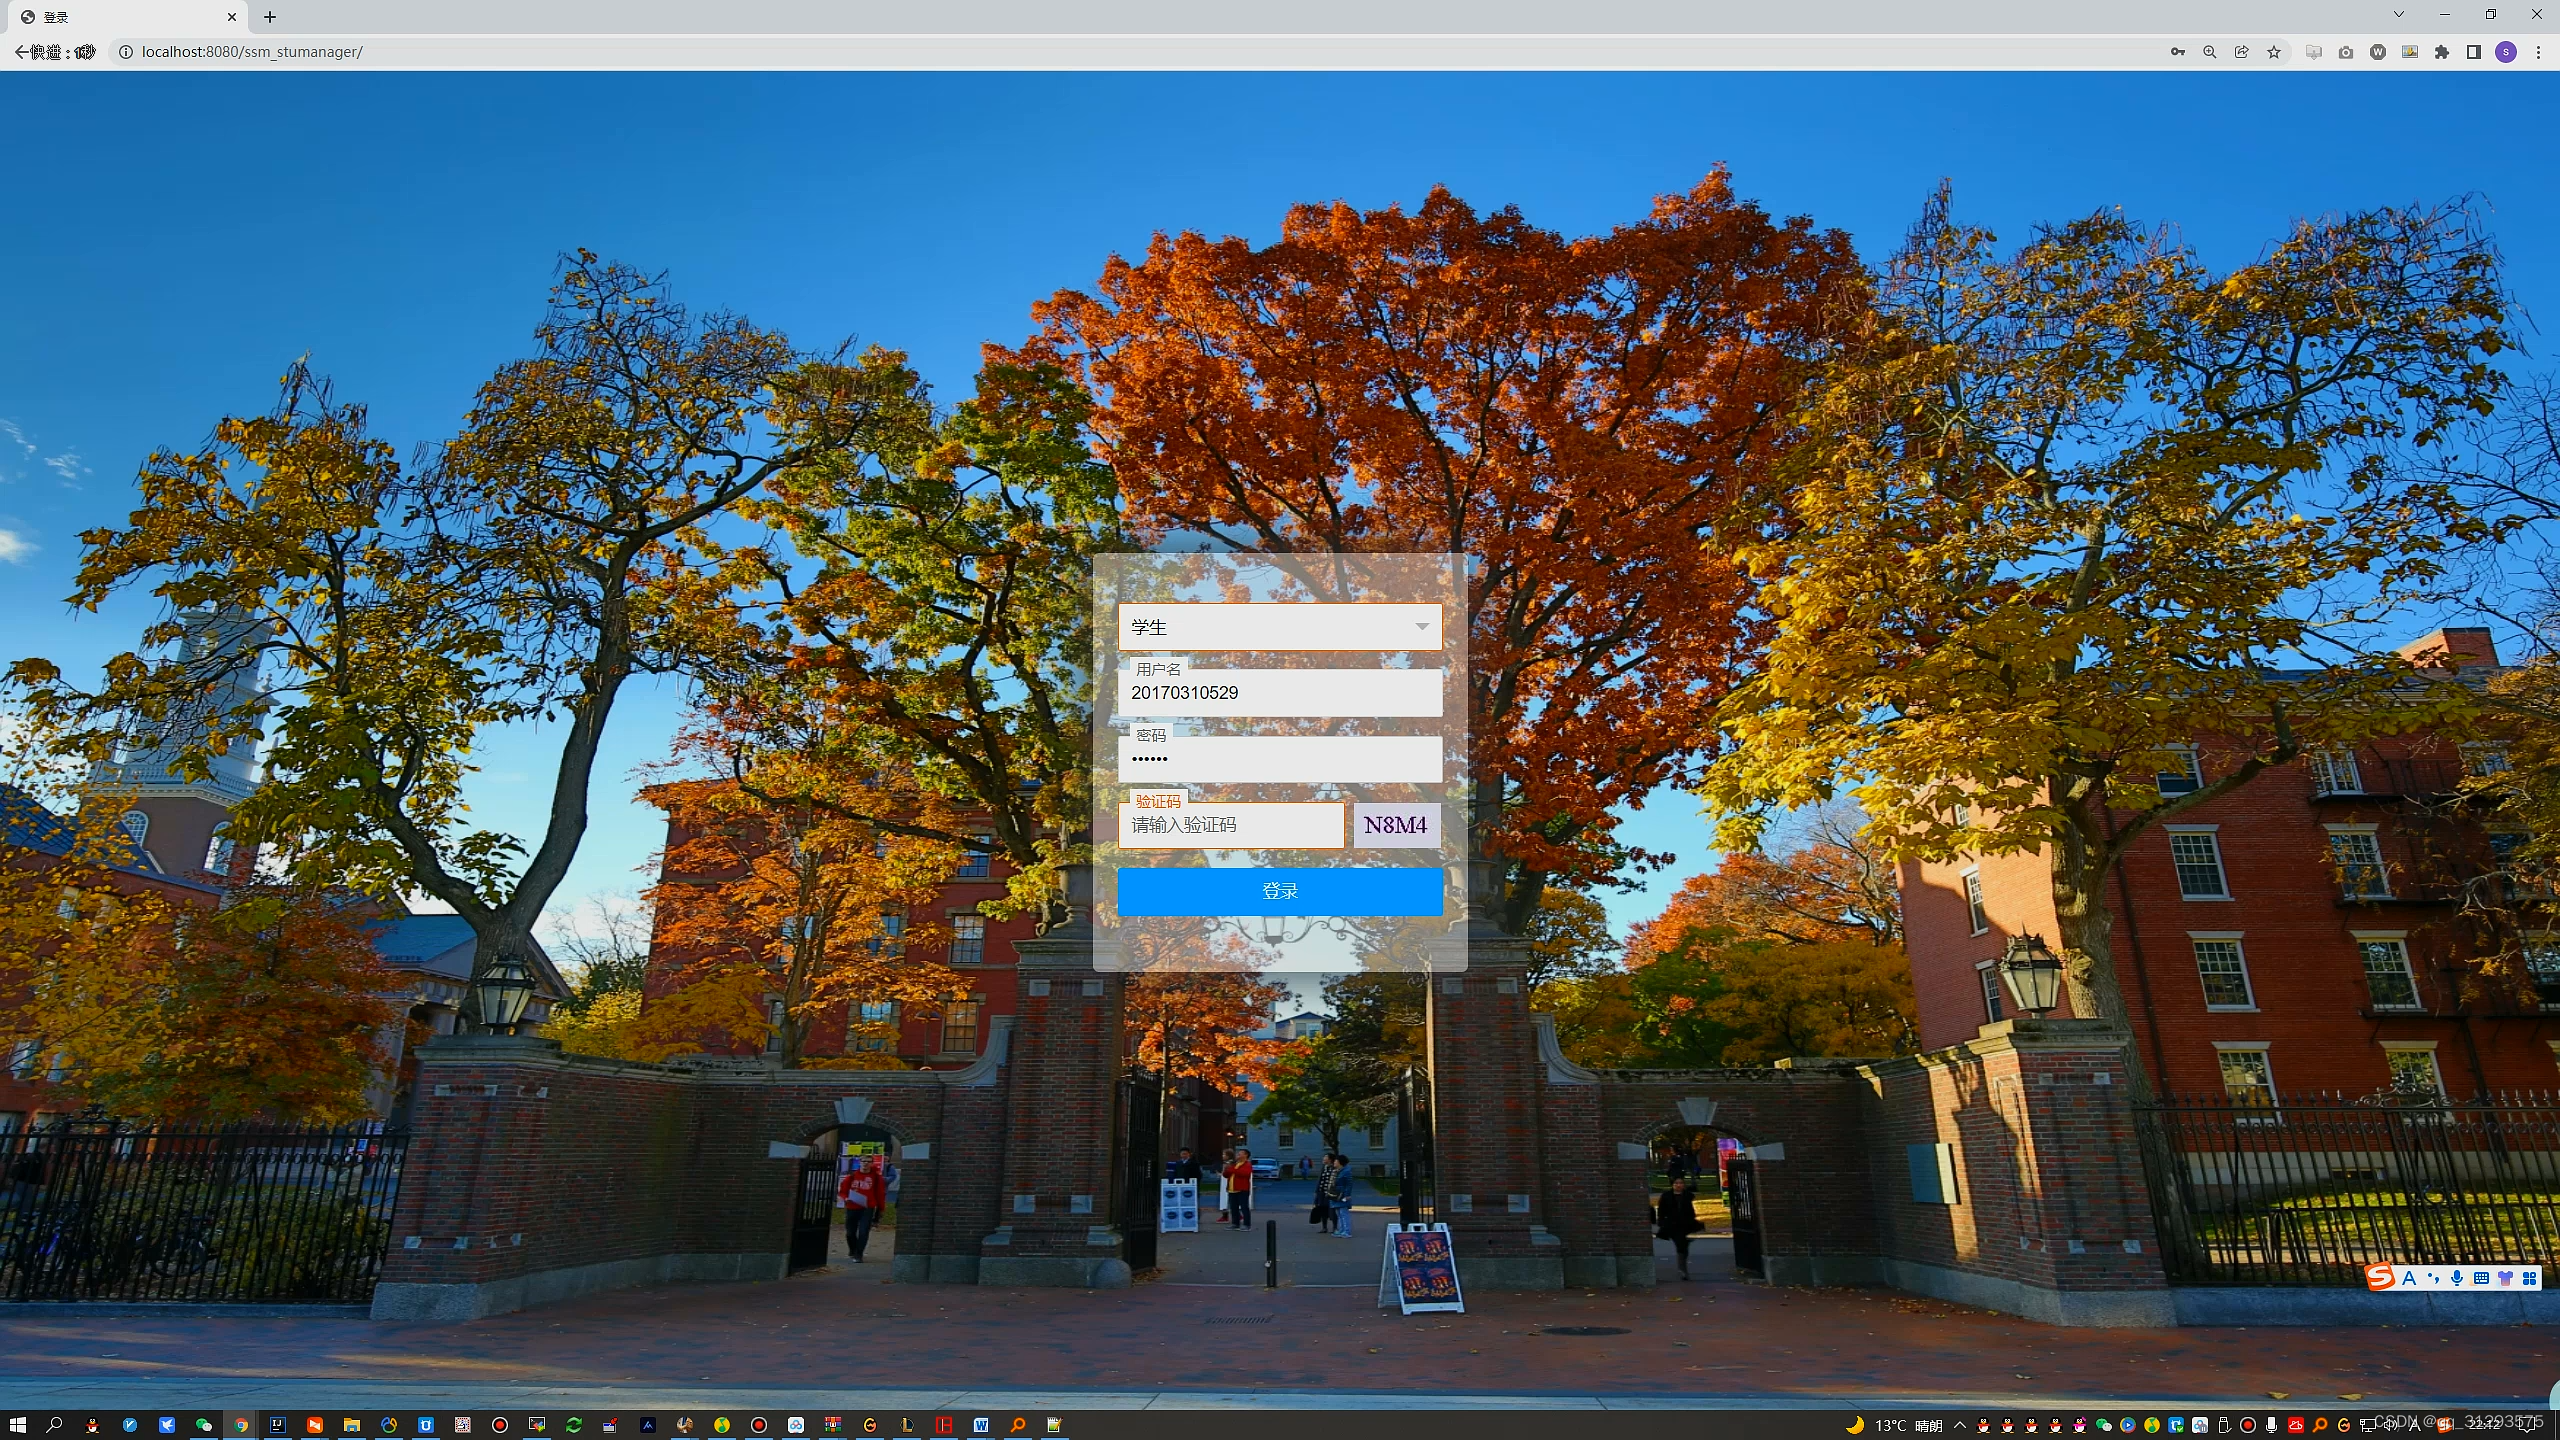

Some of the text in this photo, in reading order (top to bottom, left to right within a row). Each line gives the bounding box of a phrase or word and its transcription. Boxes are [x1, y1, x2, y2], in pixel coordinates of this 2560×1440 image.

[43, 11, 69, 24] 登录
[141, 44, 364, 62] localhost:8080/ssm_stumanager/
[1131, 618, 1168, 636] 学生
[1136, 662, 1181, 677] 用户名
[1131, 685, 1239, 700] 20170310529
[1136, 728, 1167, 743] 密码
[1136, 794, 1182, 809] 验证码
[1131, 816, 1238, 834] 请输入验证码
[1363, 815, 1429, 834] N8M4
[1262, 881, 1299, 900] 登录
[2401, 1270, 2417, 1286] A
[1915, 1419, 1943, 1433] 晴朗
